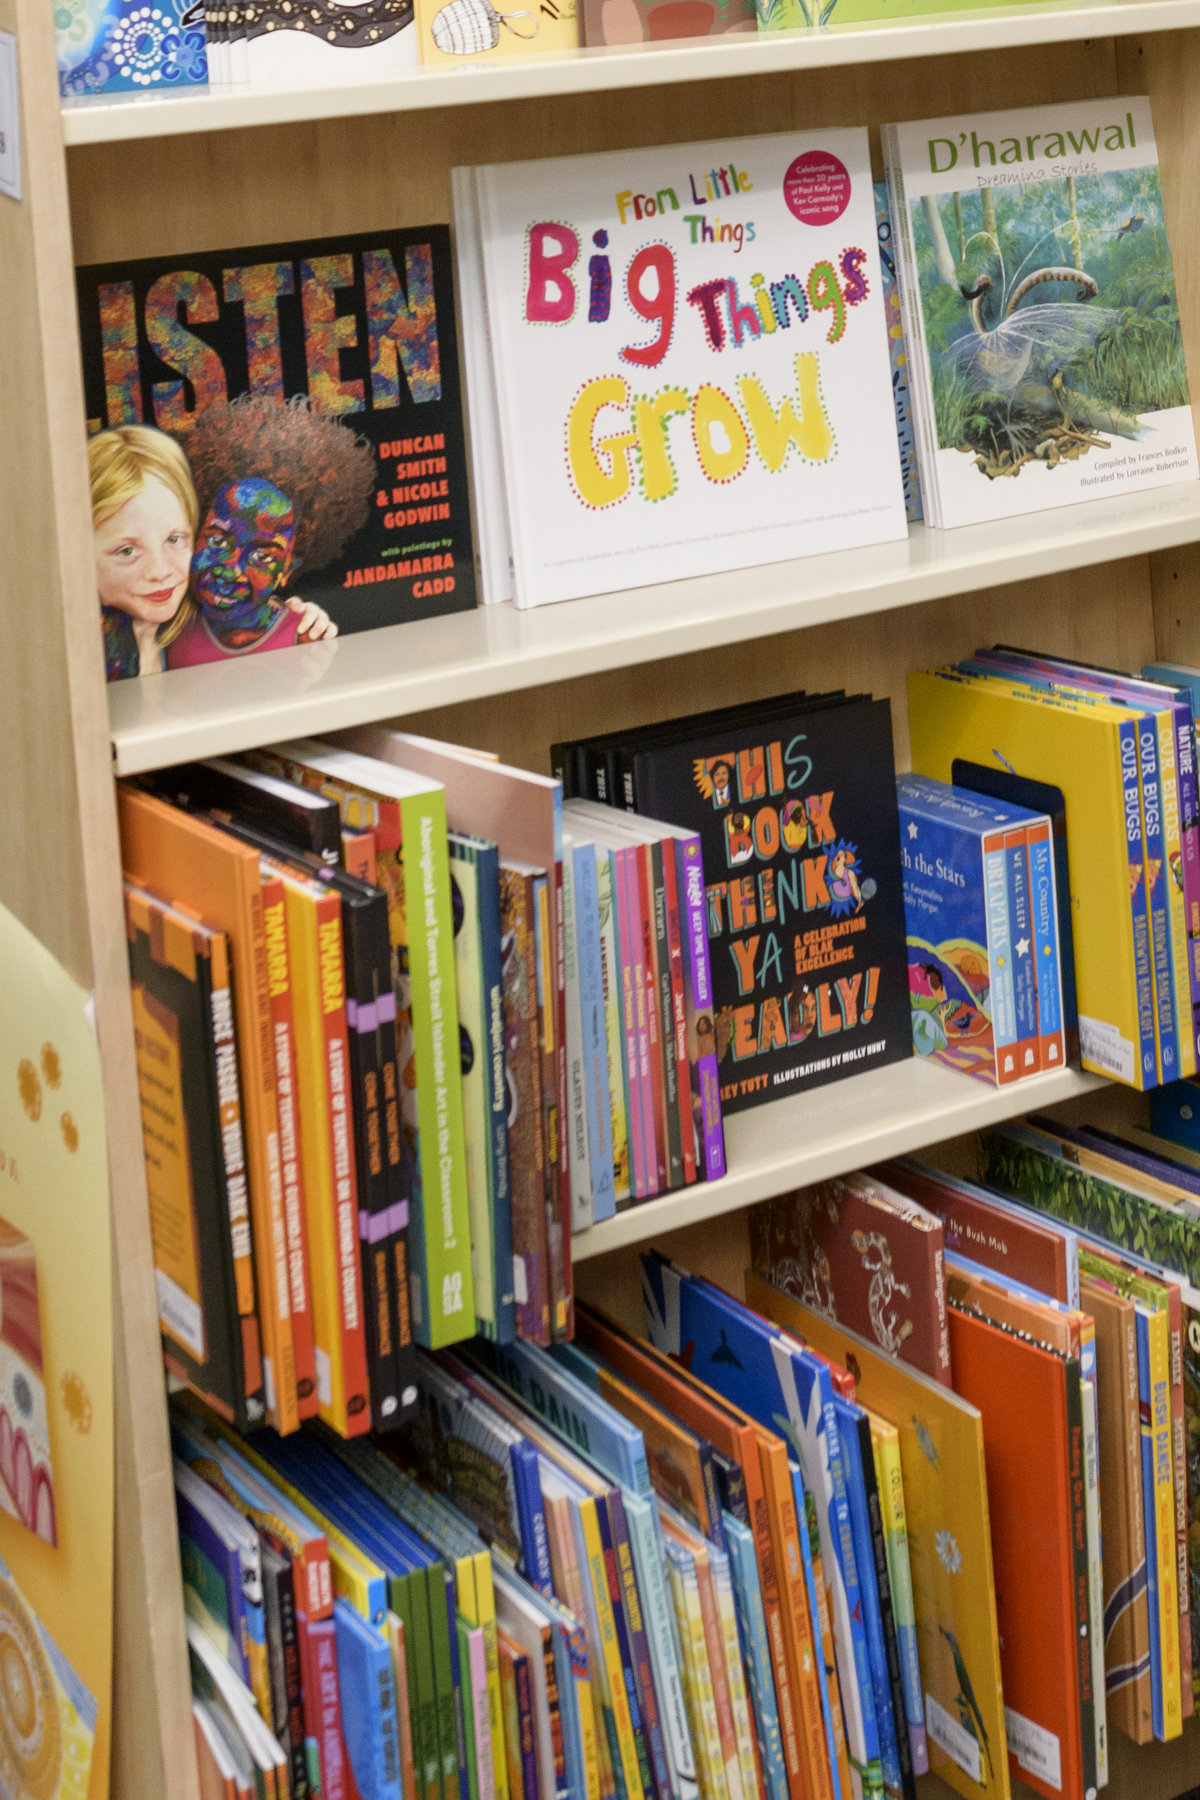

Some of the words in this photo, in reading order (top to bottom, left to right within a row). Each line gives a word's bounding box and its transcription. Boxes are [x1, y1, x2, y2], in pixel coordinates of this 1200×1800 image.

[927, 112, 1136, 174] D'harawal
[615, 187, 680, 224] From
[689, 164, 753, 205] Little
[977, 167, 1046, 188] Dreaming
[1051, 161, 1098, 179] Stories
[683, 215, 756, 253] Things
[522, 220, 679, 368] Big
[686, 247, 869, 352] Things
[86, 243, 442, 434] ISTEN
[378, 433, 446, 459] DUNCAN
[396, 456, 447, 480] SMITH
[1094, 456, 1126, 471] Compiled
[1128, 455, 1137, 464] by
[1138, 451, 1163, 462] Frances
[1164, 445, 1187, 456] Bodkin
[376, 490, 389, 507] &
[392, 479, 449, 504] NICOLE
[1080, 473, 1115, 487] Illustrated
[1116, 472, 1125, 480] by
[1126, 466, 1154, 478] Lorraine
[1156, 459, 1189, 472] Robertson
[383, 502, 450, 529] GODWIN
[343, 552, 454, 588] JANDAMARRA
[412, 576, 455, 599] CADD
[1121, 737, 1138, 781] OUR
[1139, 733, 1154, 777] OUR
[1178, 725, 1192, 774] NATURE
[702, 734, 812, 810] THIS
[1182, 782, 1192, 798] ALL
[725, 791, 836, 868] BOOK
[1124, 786, 1141, 842] BUGS
[1143, 783, 1160, 836] BUGS
[1183, 802, 1195, 840] AROUND
[418, 816, 440, 896] Aboriginal
[915, 853, 933, 877] the
[936, 857, 965, 889] Stars
[1013, 851, 1023, 868] WE
[1035, 847, 1049, 873] My
[1186, 845, 1195, 861] US
[706, 842, 860, 937] THINKS
[987, 857, 1007, 950] DREAMERS
[1014, 874, 1024, 891] ALL
[424, 898, 440, 924] and
[1016, 896, 1026, 929] SLEEP
[1037, 876, 1052, 935] Country
[426, 926, 442, 976] Torres
[795, 945, 807, 961] OF
[808, 939, 834, 957] BLAK
[803, 916, 866, 945] CELEBRATION
[1134, 914, 1150, 970] BRONWYN
[1152, 909, 1169, 968] BRONWYN
[730, 932, 783, 996] YA
[795, 945, 855, 975] EXCELLENCE
[210, 988, 235, 1042] BRUCE
[429, 978, 446, 1016] Strait
[490, 985, 504, 1049] wiradjuri
[1137, 972, 1154, 1040] BANCROFT
[1156, 971, 1173, 1034] BANCROFT
[431, 1020, 448, 1083] Islander
[773, 1058, 831, 1085] ILLUSTRATIONS
[831, 1055, 842, 1072] BY
[842, 1047, 867, 1070] MOLLY
[867, 1040, 887, 1062] HUNT
[214, 1044, 238, 1108] PASCOE
[492, 1053, 505, 1112] country
[434, 1086, 450, 1112] Art
[436, 1114, 450, 1125] in
[221, 1119, 243, 1173] YOUNG
[438, 1128, 453, 1153] the
[224, 1175, 247, 1220] DARK
[438, 1156, 456, 1234] Classroom
[229, 1222, 251, 1258] EMU
[444, 1237, 457, 1249] 2
[1126, 1325, 1136, 1353] Little
[1169, 1331, 1182, 1385] FAMILY
[1128, 1354, 1138, 1381] Bird's
[1126, 1384, 1138, 1399] Day
[823, 1403, 840, 1457] COMING
[1173, 1418, 1185, 1459] MUIR
[1177, 1544, 1190, 1615] SEYMOUR
[625, 1587, 641, 1632] COUNTRY
